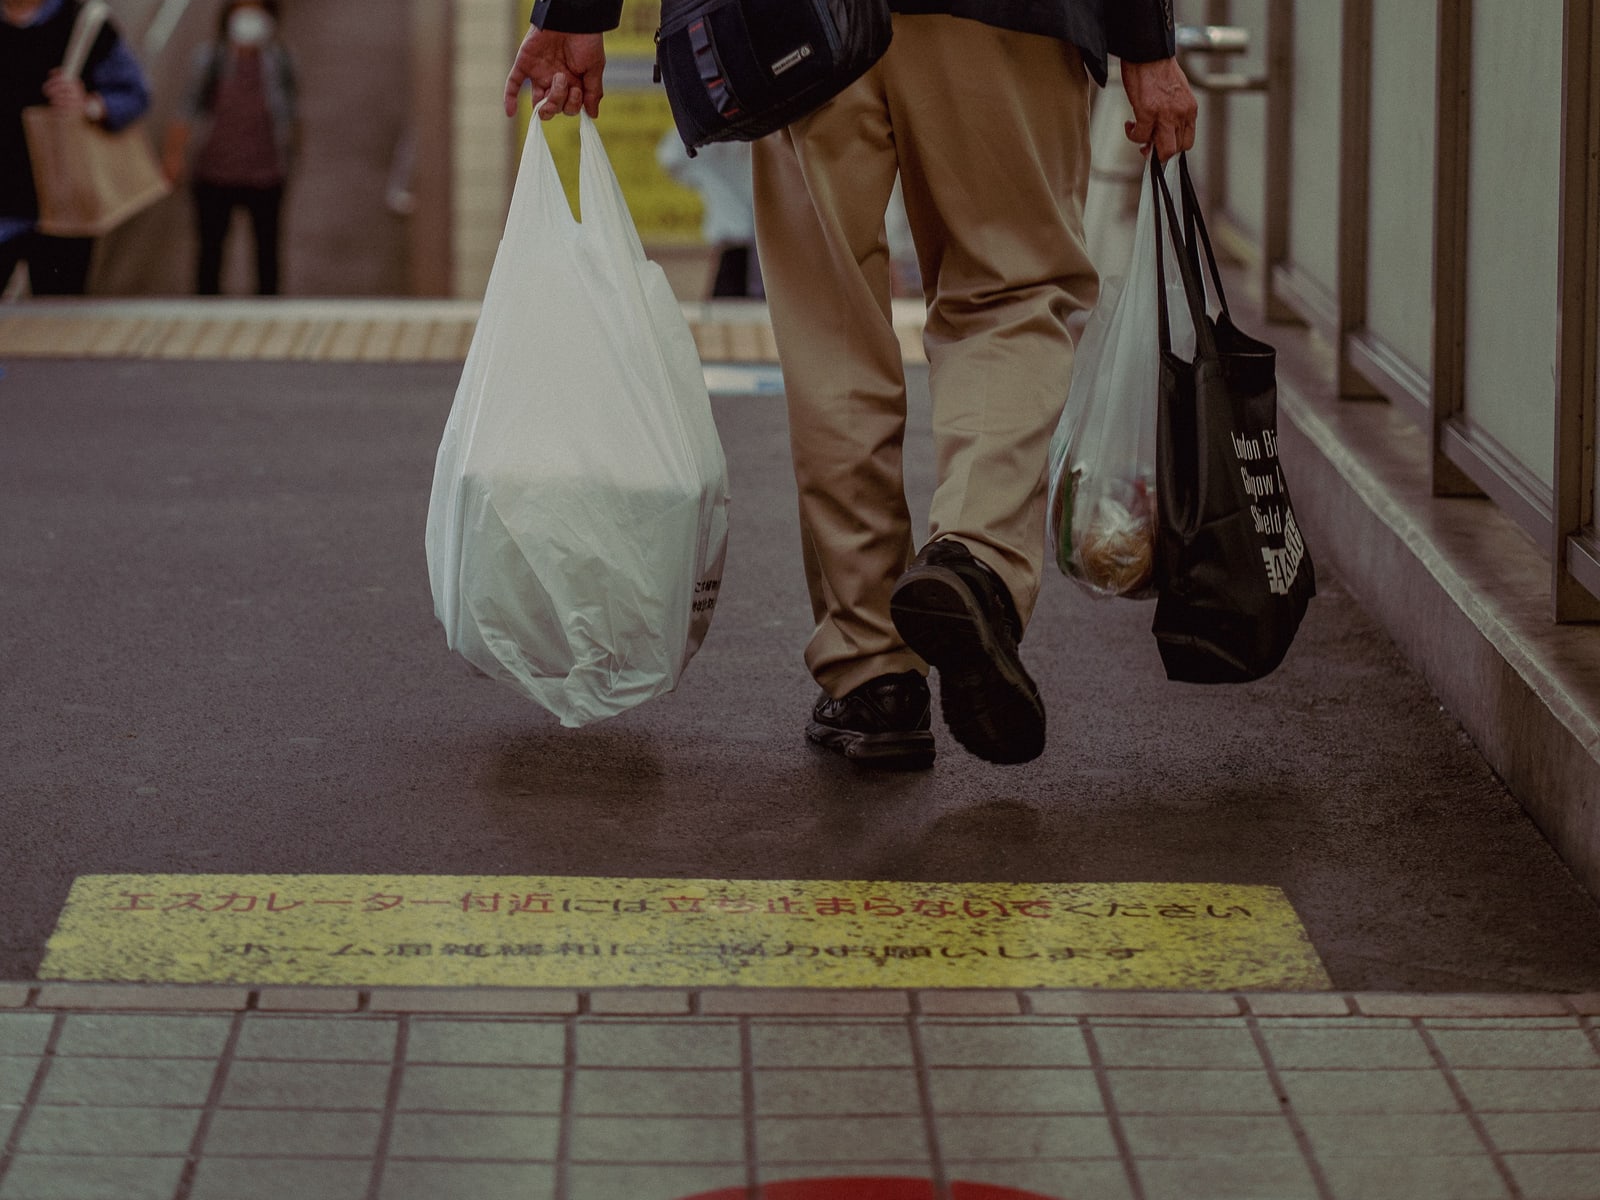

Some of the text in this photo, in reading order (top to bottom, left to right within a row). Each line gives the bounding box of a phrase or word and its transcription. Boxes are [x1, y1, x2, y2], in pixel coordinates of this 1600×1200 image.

[109, 889, 1253, 919] エスカレーター付近には立ち止まらないでください
